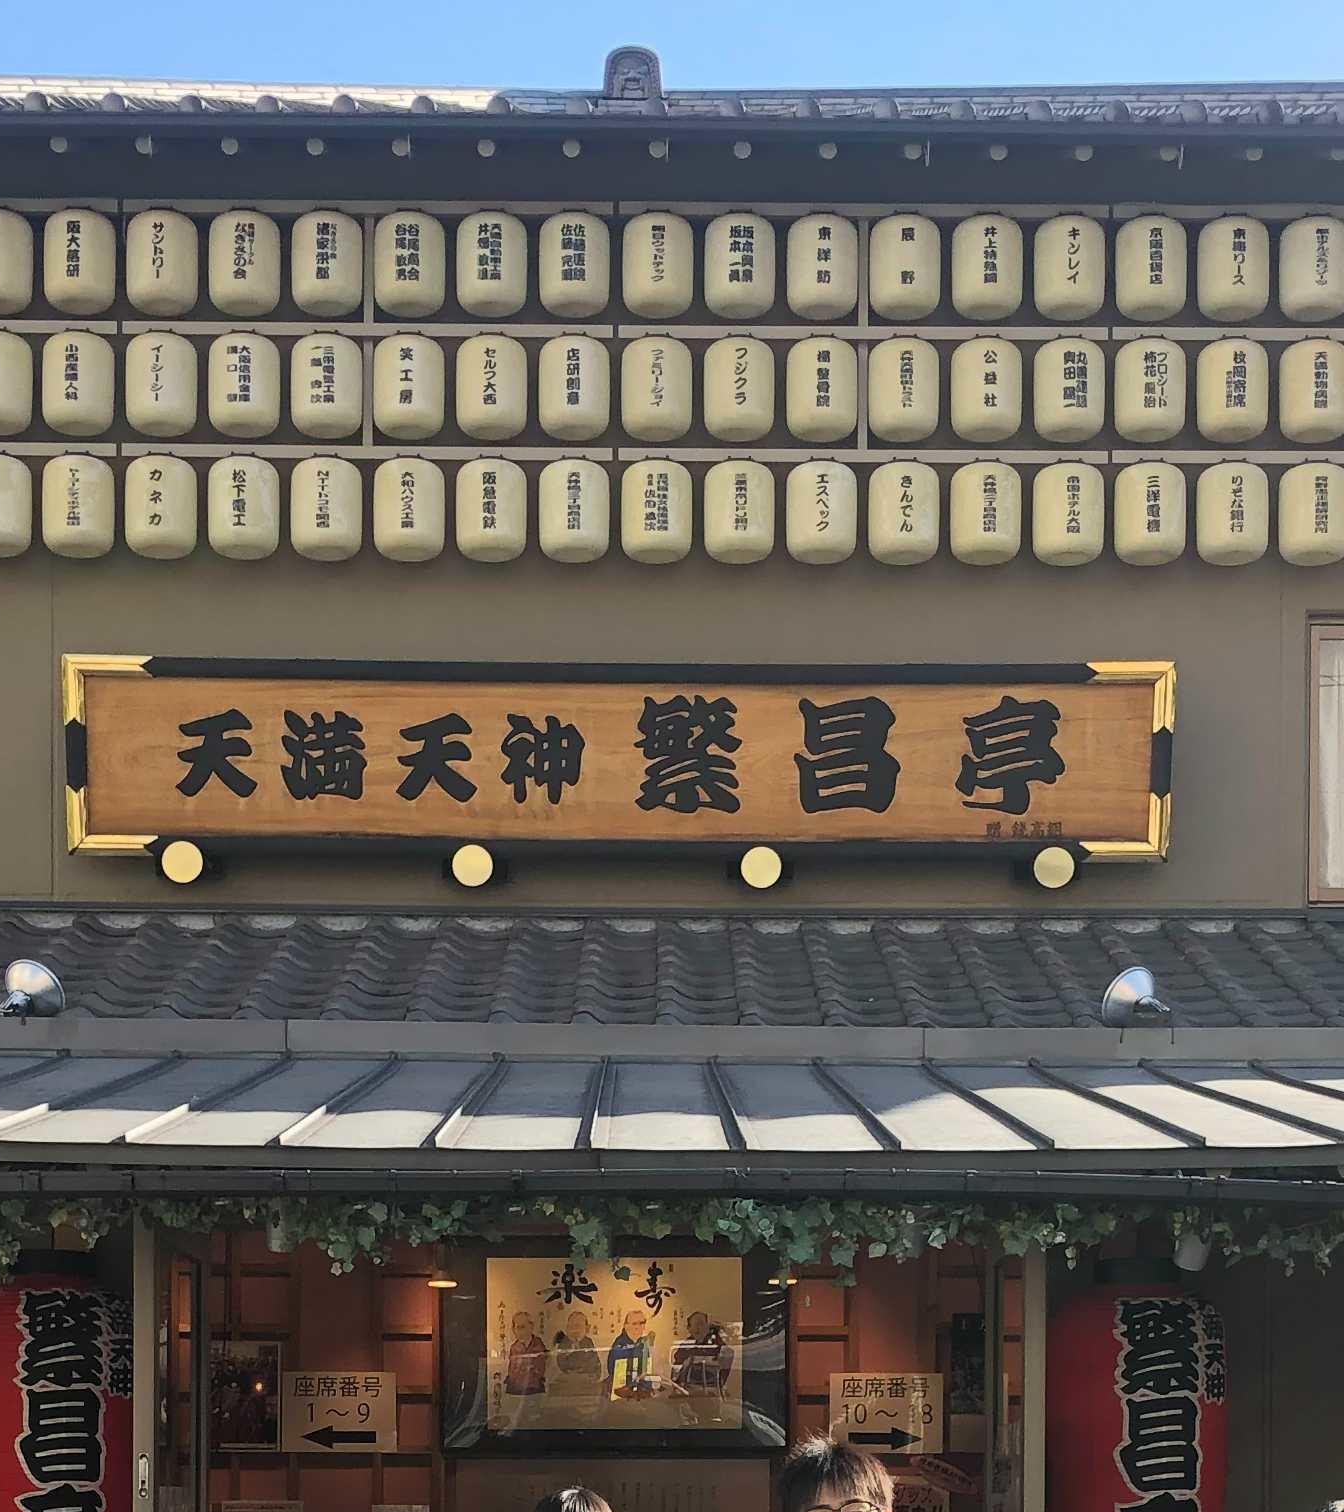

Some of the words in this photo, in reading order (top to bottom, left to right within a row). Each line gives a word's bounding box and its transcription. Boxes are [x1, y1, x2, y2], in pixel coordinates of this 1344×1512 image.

[66, 220, 81, 278] 阪大落研
[152, 222, 165, 279] サントリー
[817, 226, 831, 284] 東洋紡
[1067, 227, 1080, 284] キンレイ
[150, 344, 164, 402] イーシーシー
[237, 345, 252, 402] 大阪信用金庫
[399, 346, 414, 404] 笑工房
[483, 347, 496, 405] セルフ大西
[566, 347, 580, 405] 店研創意
[734, 347, 748, 405] フジクラ
[984, 350, 997, 407] 公益社
[148, 468, 162, 526] カネカ
[232, 468, 246, 526] 松下電工
[400, 472, 416, 528] 大和ハウス工業
[482, 472, 496, 529] 阪急電鉄
[816, 473, 830, 532] エスペック
[900, 474, 913, 533] きんでん
[1066, 475, 1080, 534] 帝国ホテル大阪
[1145, 476, 1160, 533] 三洋電機
[1230, 475, 1244, 533] りそな銀行
[176, 694, 1066, 816] 天満天神繁昌亭
[293, 1375, 382, 1398] 座席番号
[841, 1377, 929, 1399] 座席番号
